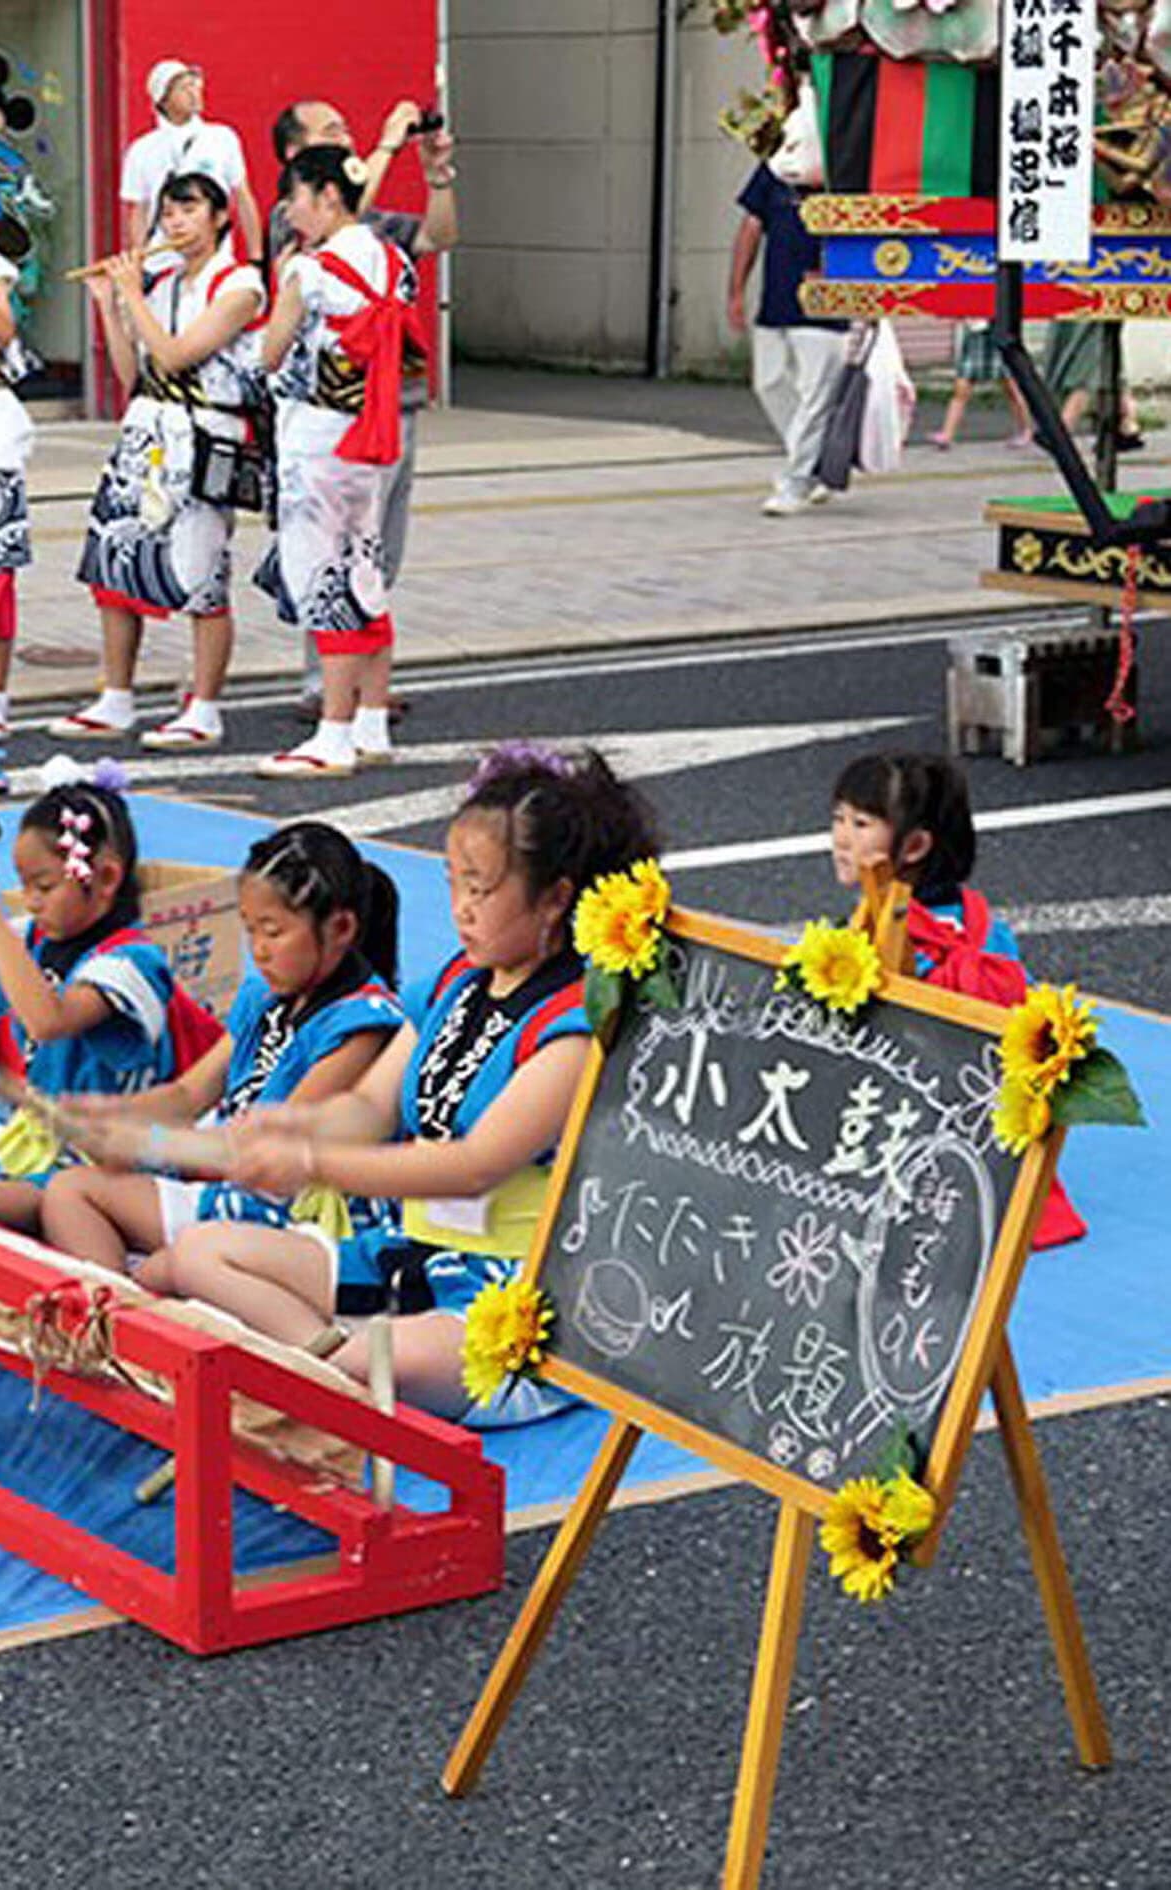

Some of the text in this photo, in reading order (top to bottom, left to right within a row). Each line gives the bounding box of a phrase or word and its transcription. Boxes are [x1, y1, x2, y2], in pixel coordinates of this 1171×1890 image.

[652, 1029, 921, 1201] 小太鼓
[612, 1179, 759, 1285] たたき
